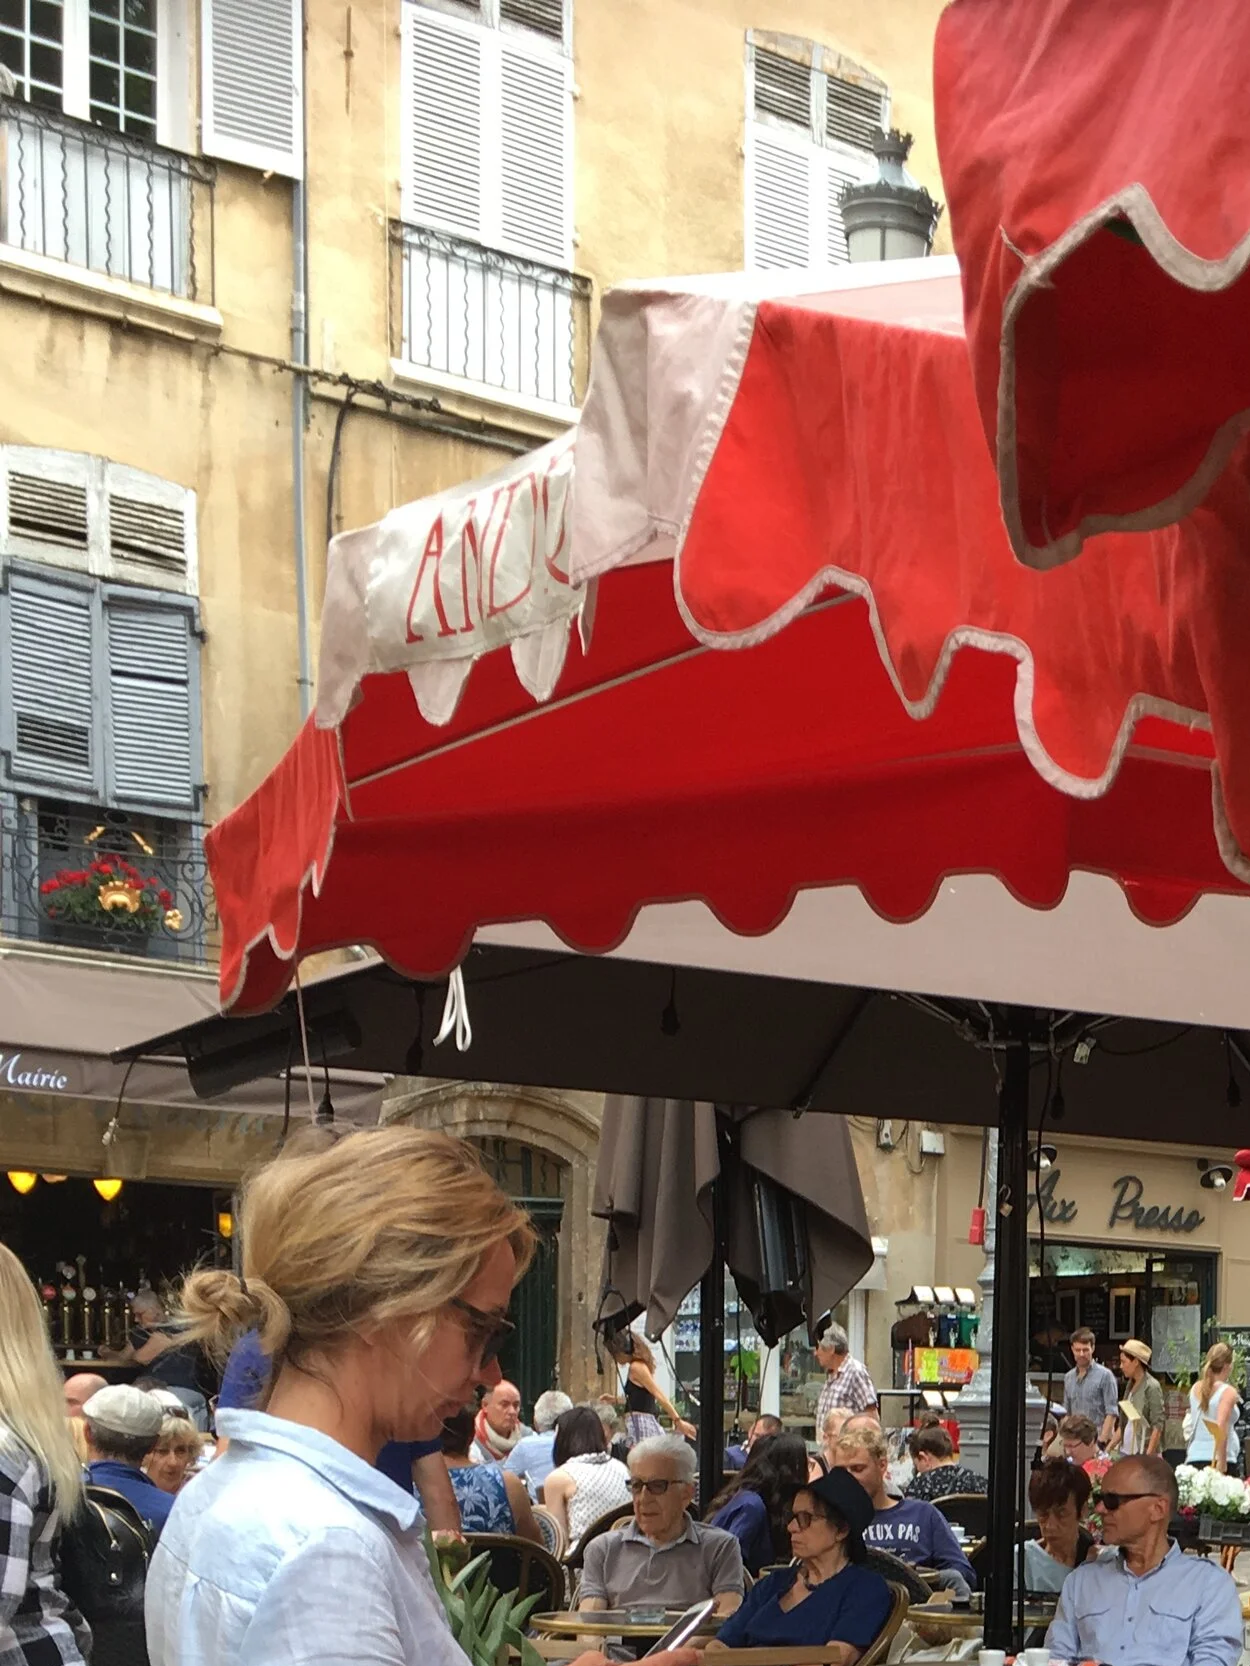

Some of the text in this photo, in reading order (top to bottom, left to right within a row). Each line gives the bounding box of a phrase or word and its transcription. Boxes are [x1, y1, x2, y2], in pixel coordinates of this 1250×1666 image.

[0, 1053, 68, 1089] Mairie
[1108, 1175, 1206, 1234] Presso
[898, 1523, 920, 1543] PAS
